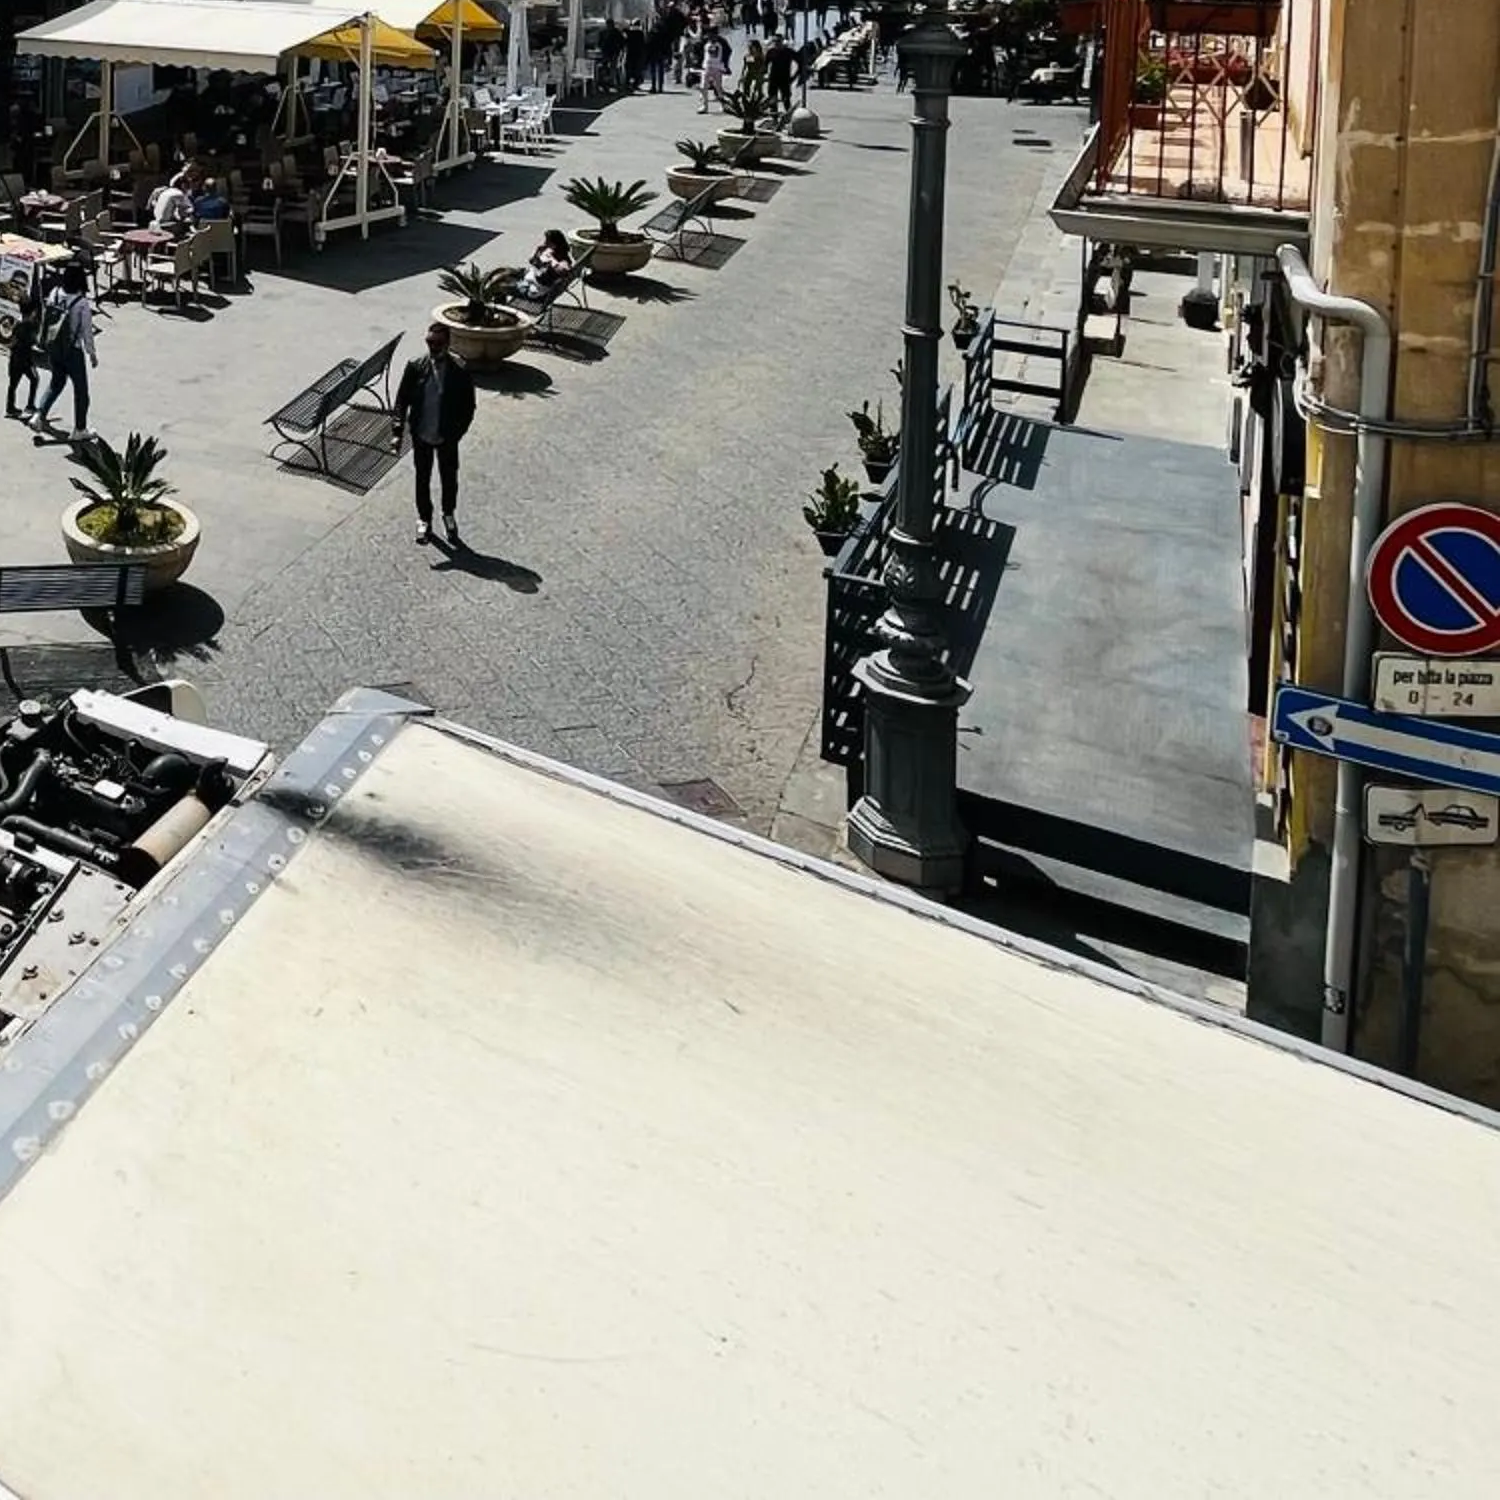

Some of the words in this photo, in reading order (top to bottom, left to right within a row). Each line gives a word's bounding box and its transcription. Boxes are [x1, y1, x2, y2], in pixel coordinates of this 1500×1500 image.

[1393, 670, 1414, 685] per
[1444, 667, 1456, 685] la
[1457, 672, 1493, 687] piazza
[1452, 691, 1474, 707] 24
